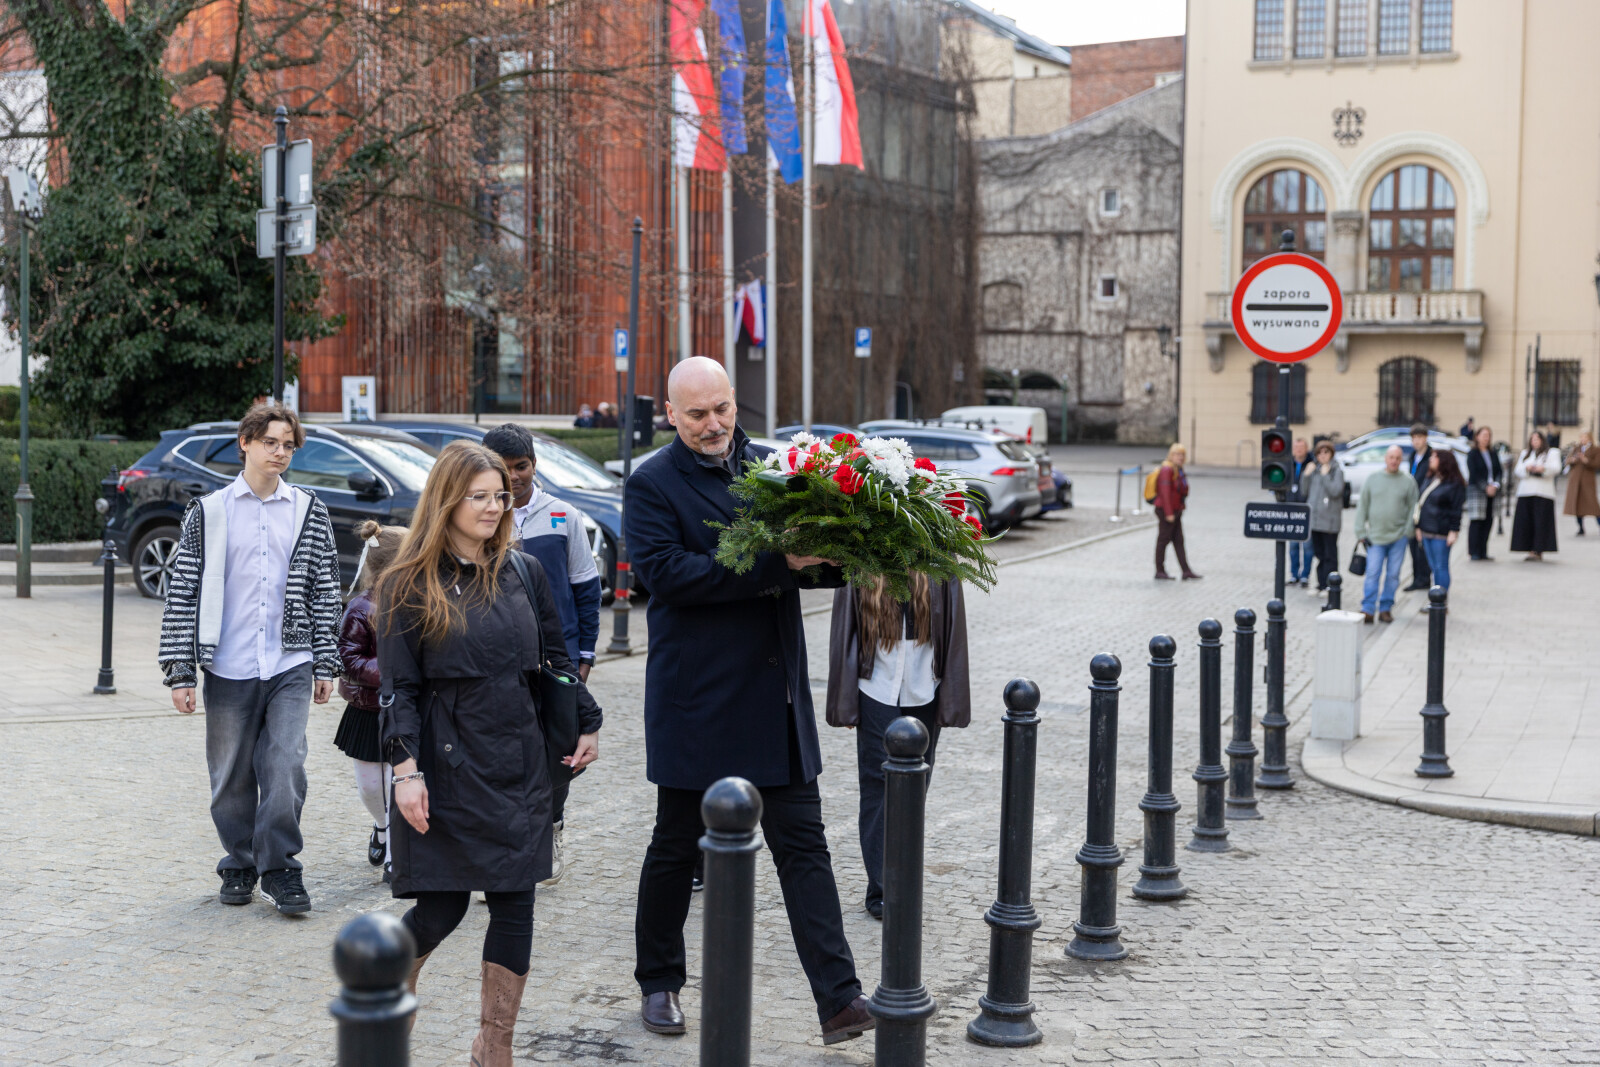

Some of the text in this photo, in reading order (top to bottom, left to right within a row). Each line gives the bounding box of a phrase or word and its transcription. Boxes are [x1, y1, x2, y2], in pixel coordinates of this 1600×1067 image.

[1264, 290, 1310, 302] zapora
[1252, 319, 1319, 330] wysuwana
[617, 332, 627, 353] P
[1248, 510, 1306, 520] PORTIERNIA UMK
[1249, 523, 1262, 531] TEL.
[1264, 523, 1272, 532] 12
[1286, 525, 1294, 533] 17
